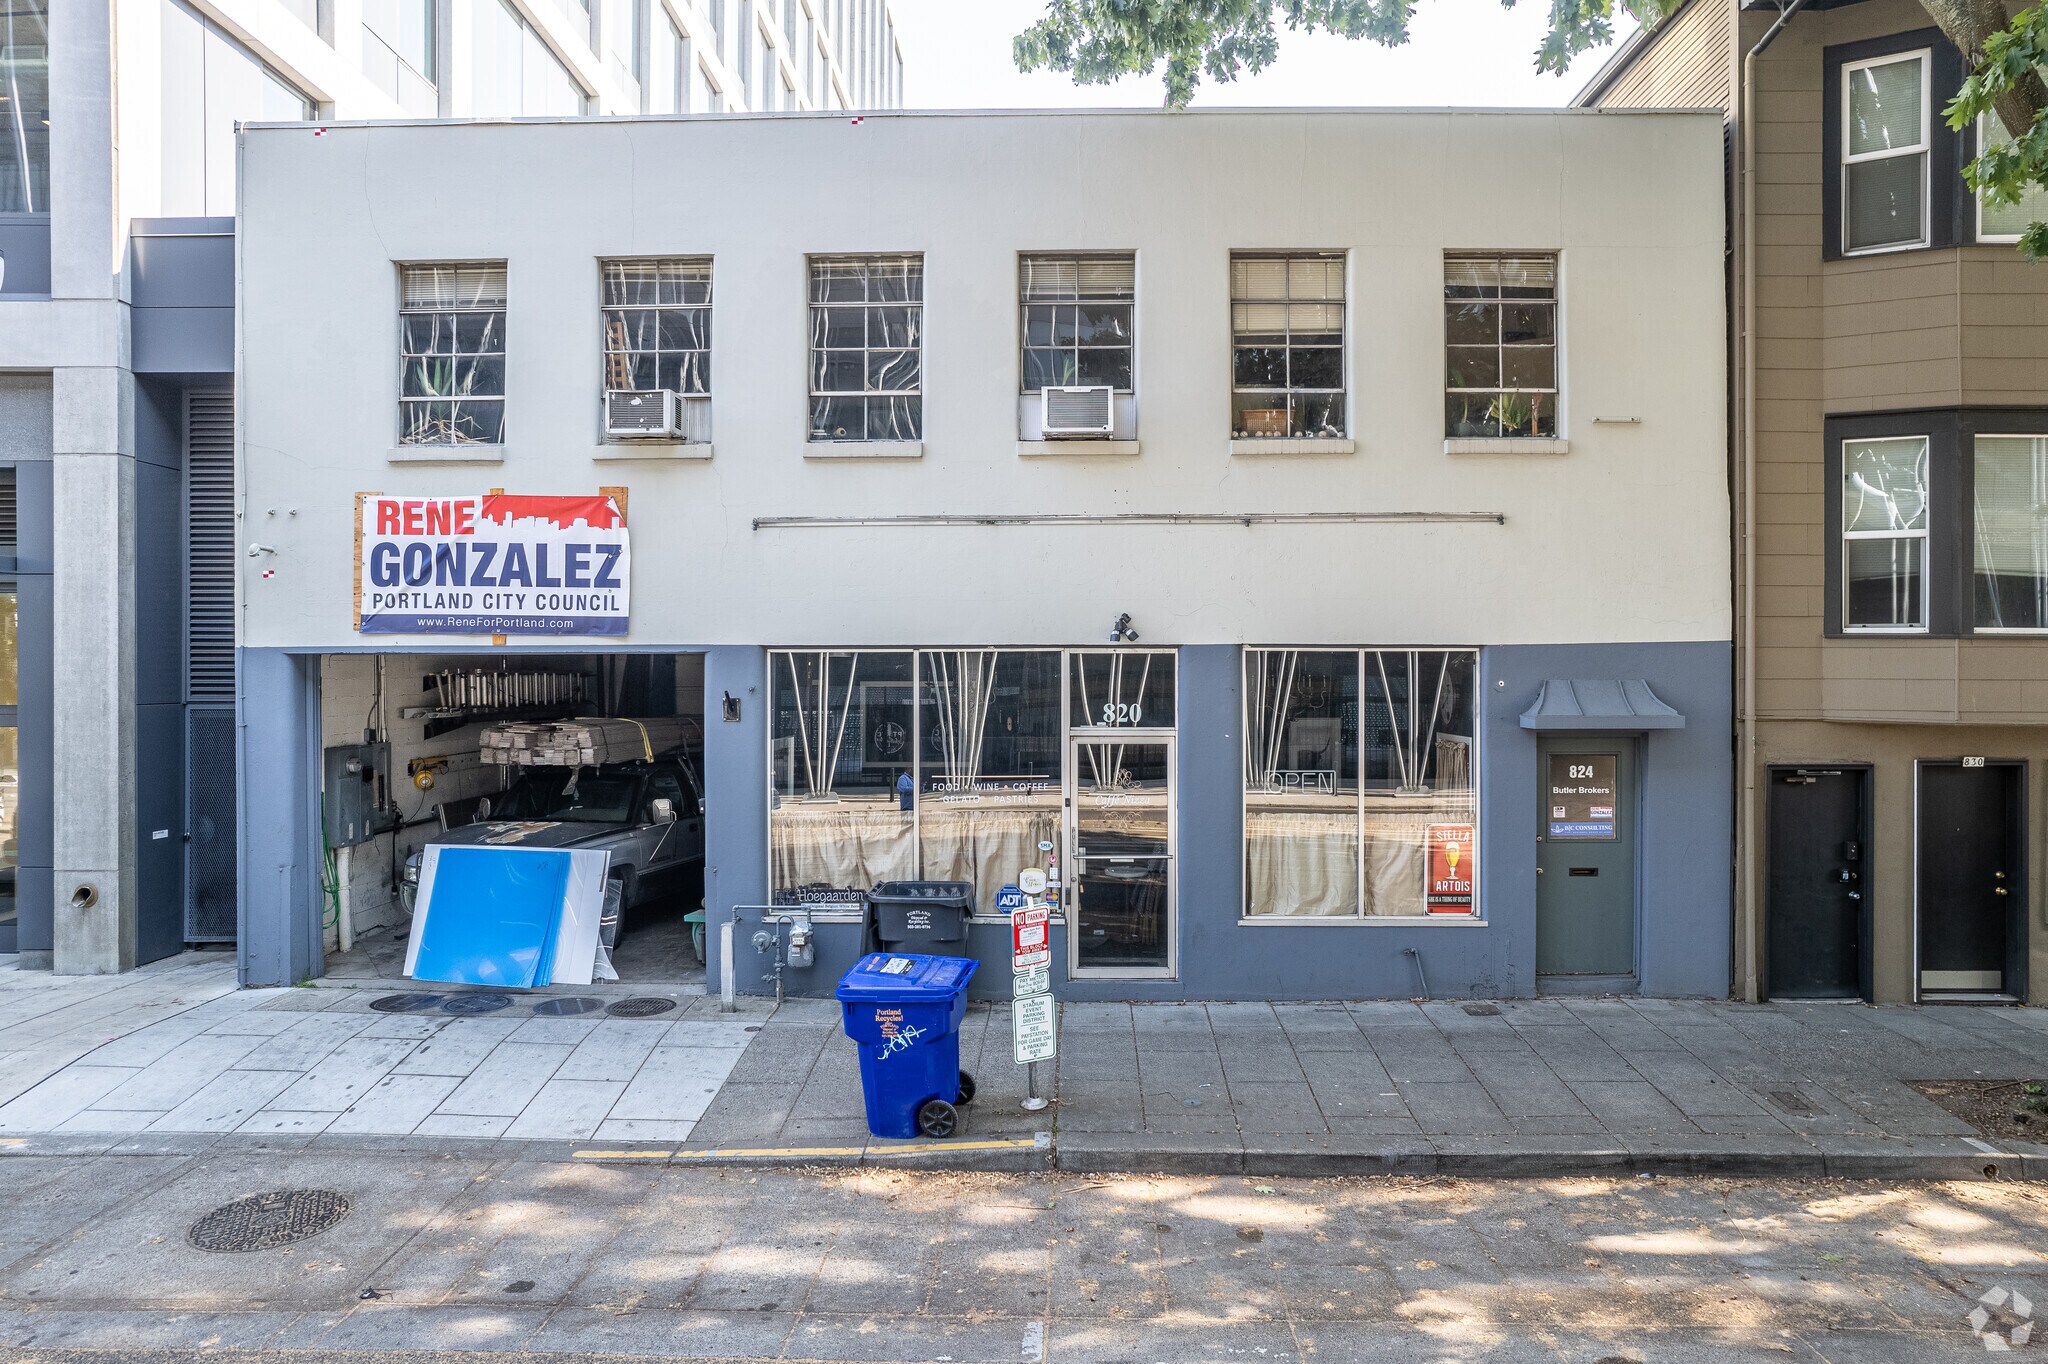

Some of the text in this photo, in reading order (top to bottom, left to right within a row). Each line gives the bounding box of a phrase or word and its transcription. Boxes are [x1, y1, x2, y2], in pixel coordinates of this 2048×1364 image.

[377, 500, 475, 535] RENE
[370, 541, 622, 589] GONZALEZ
[373, 592, 620, 611] PORTLAND CITY COUNCIL
[417, 616, 574, 628] www.ReneForPortland.com
[1103, 703, 1142, 723] 820
[1964, 758, 1983, 766] 830
[1569, 765, 1593, 778] 824
[932, 782, 1049, 791] FOOD WINE COFFEE
[1267, 772, 1333, 794] OPEN
[1552, 786, 1610, 794] Butler Brokers
[943, 795, 1039, 804] GELATO PASTRIES
[1436, 830, 1470, 842] STELLA
[1436, 880, 1470, 892] ARTOIS
[797, 888, 864, 904] Hoegaarden
[1000, 894, 1021, 906] ADT
[1015, 913, 1025, 926] NO
[1027, 911, 1046, 922] PARKING
[1022, 1016, 1045, 1024] DISTRICT
[1021, 1030, 1049, 1039] PAYSTATION
[1043, 1034, 1052, 1042] DAY
[1027, 1041, 1048, 1050] PARKING
